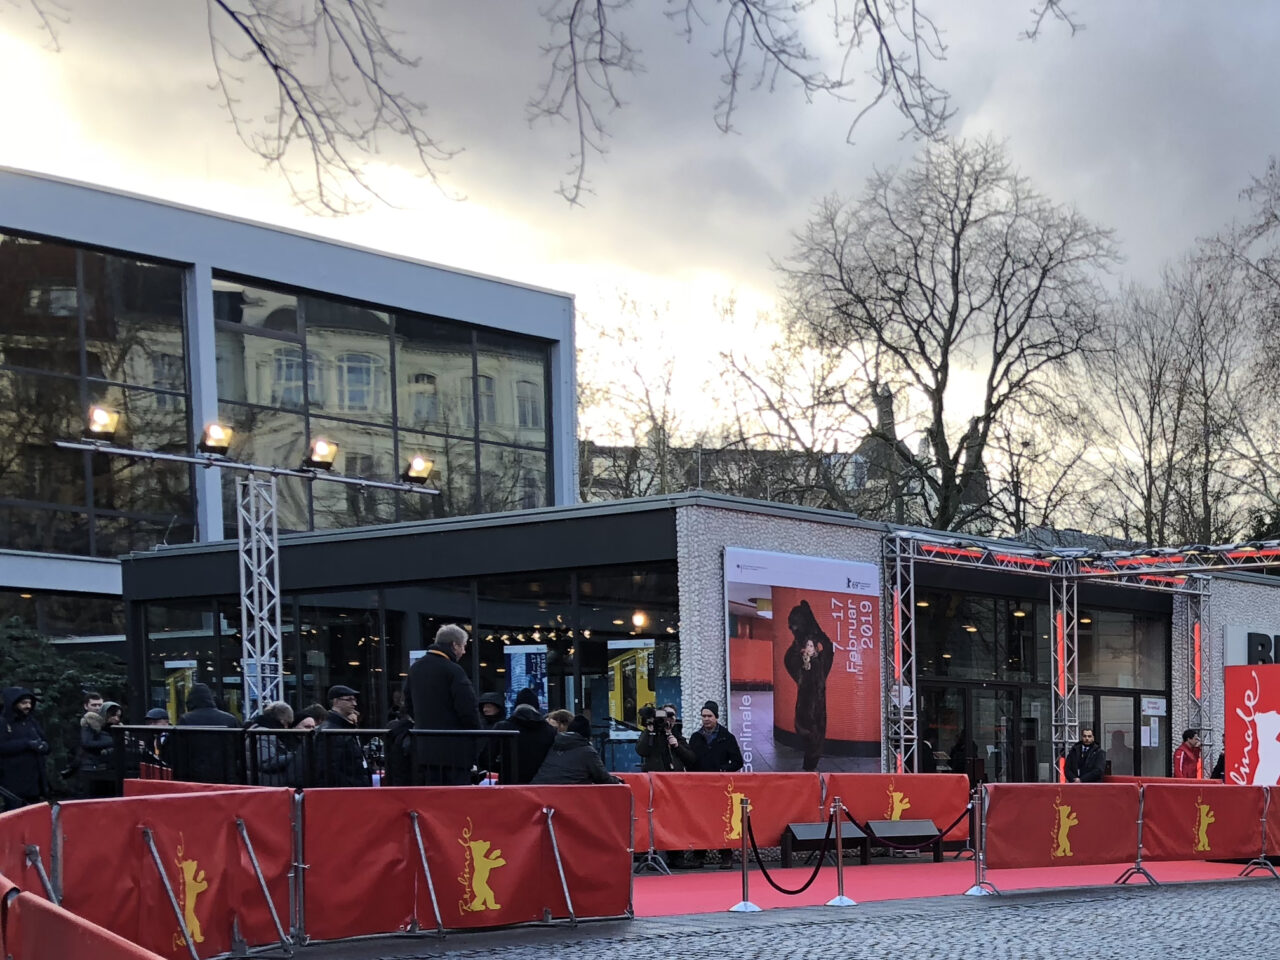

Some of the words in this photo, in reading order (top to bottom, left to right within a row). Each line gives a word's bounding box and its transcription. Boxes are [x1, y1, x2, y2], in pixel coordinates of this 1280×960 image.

[846, 599, 858, 673] Februar
[860, 600, 873, 649] 2019
[457, 815, 473, 916] Berlinale
